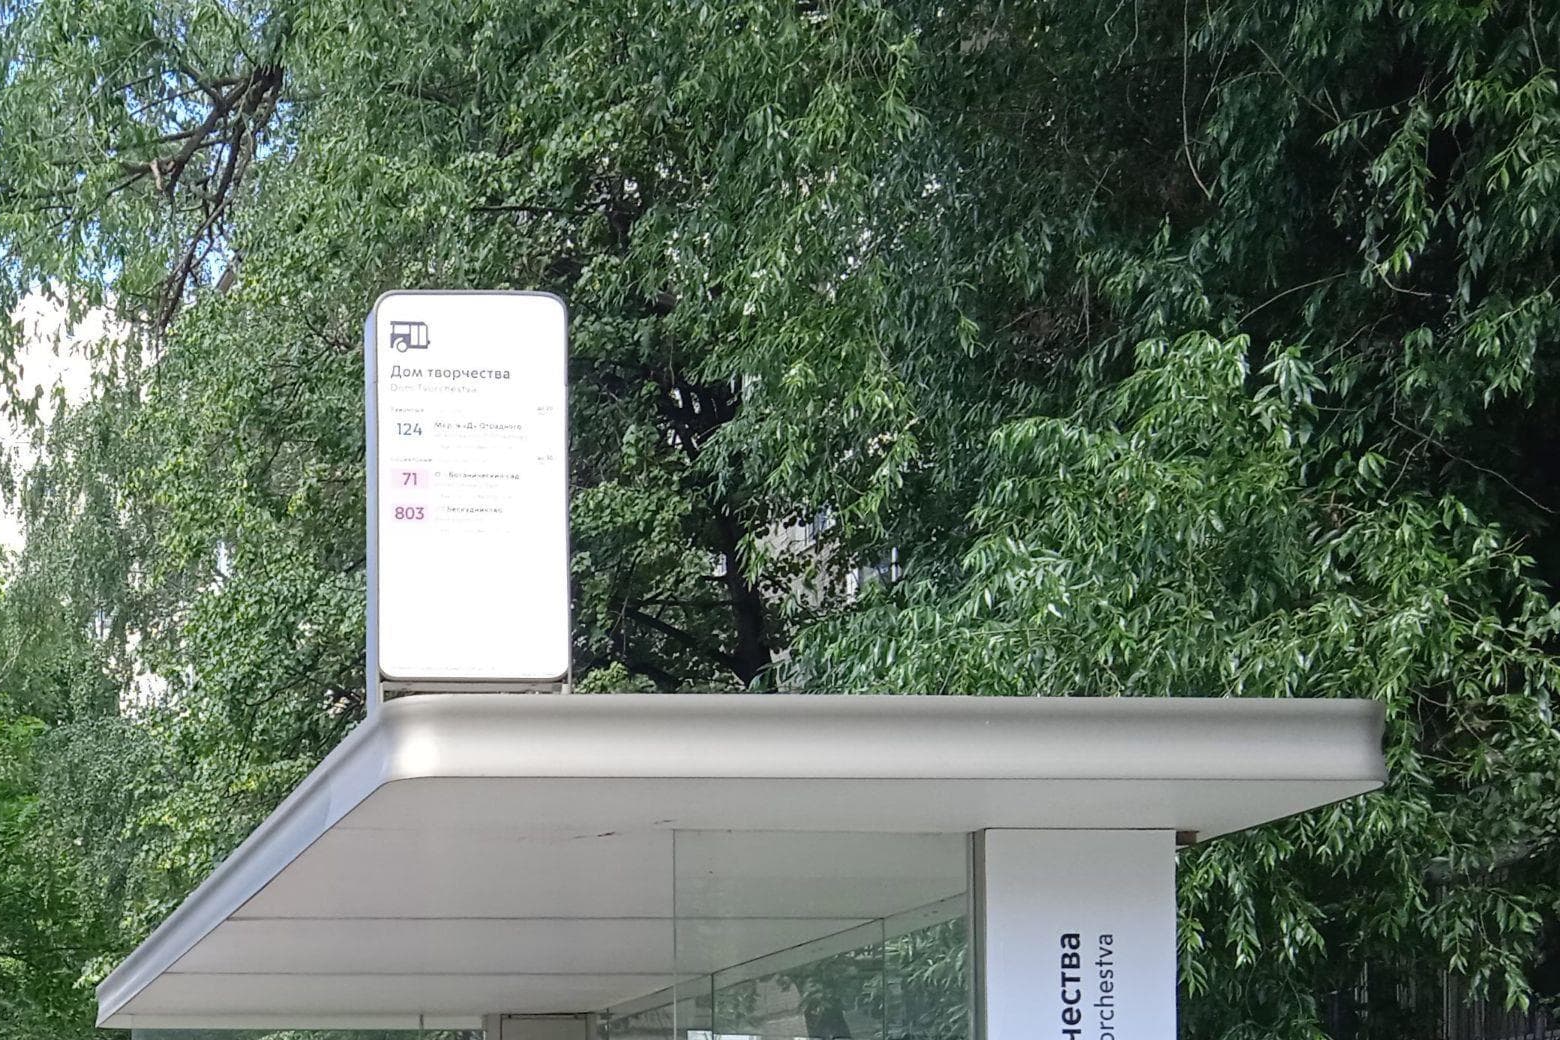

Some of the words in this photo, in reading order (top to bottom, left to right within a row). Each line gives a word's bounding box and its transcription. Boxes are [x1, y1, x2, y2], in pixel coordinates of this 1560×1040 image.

[390, 365, 423, 379] Дом
[427, 369, 511, 381] творчества
[396, 422, 423, 436] 124
[401, 472, 418, 486] 71
[394, 506, 425, 520] 803
